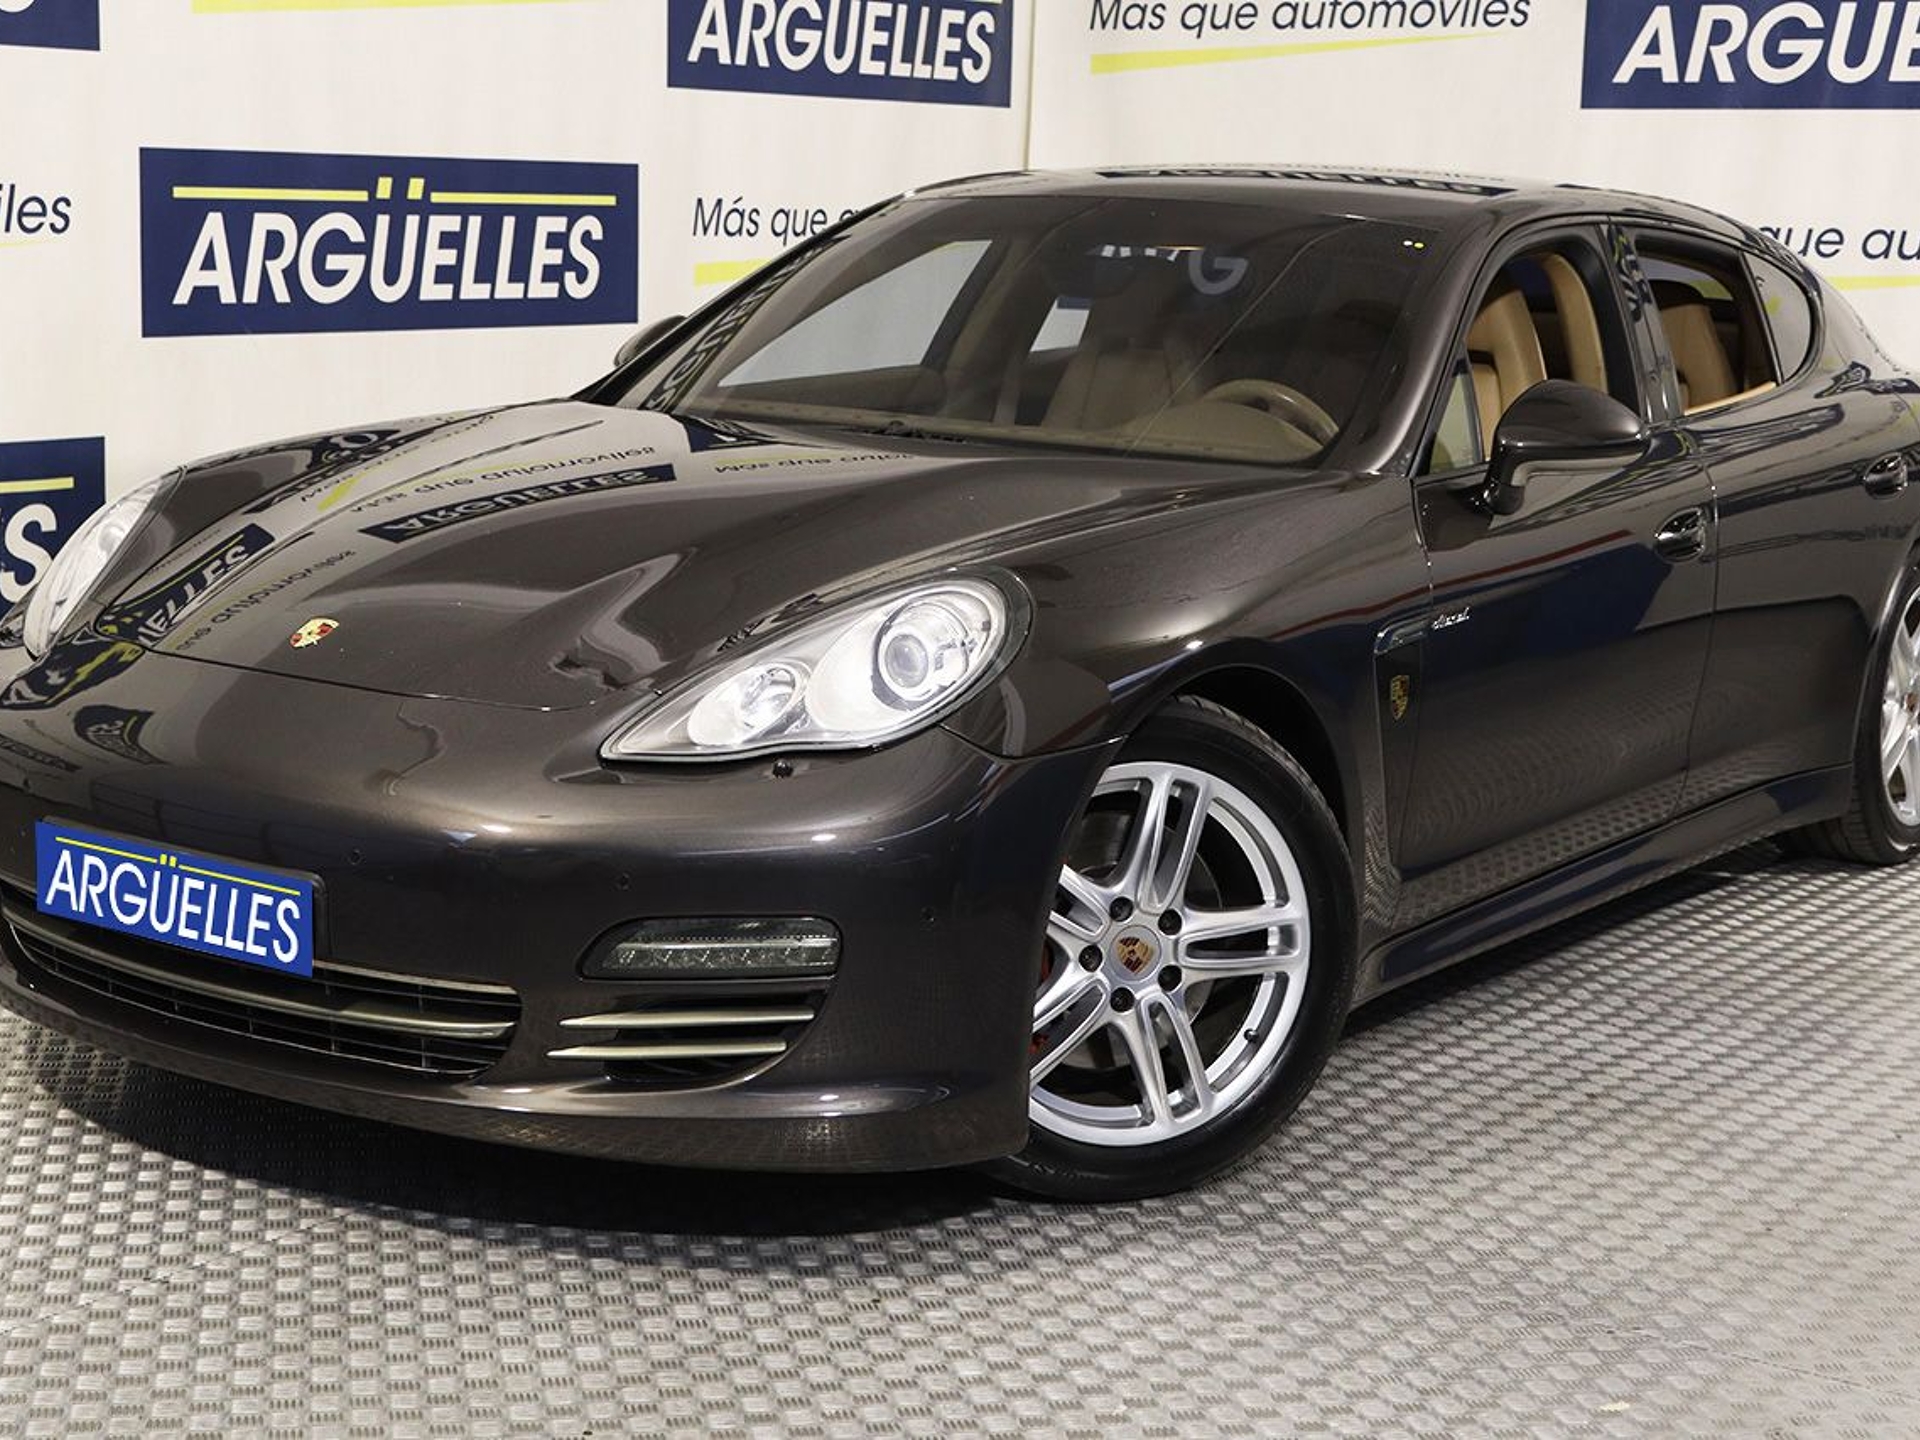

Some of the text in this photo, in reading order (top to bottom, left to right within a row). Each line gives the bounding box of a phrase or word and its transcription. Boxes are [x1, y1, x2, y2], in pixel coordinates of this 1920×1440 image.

[1181, 3, 1258, 39] que
[693, 197, 760, 237] Más
[771, 207, 828, 246] que
[45, 848, 302, 964] ARGÜELLES
